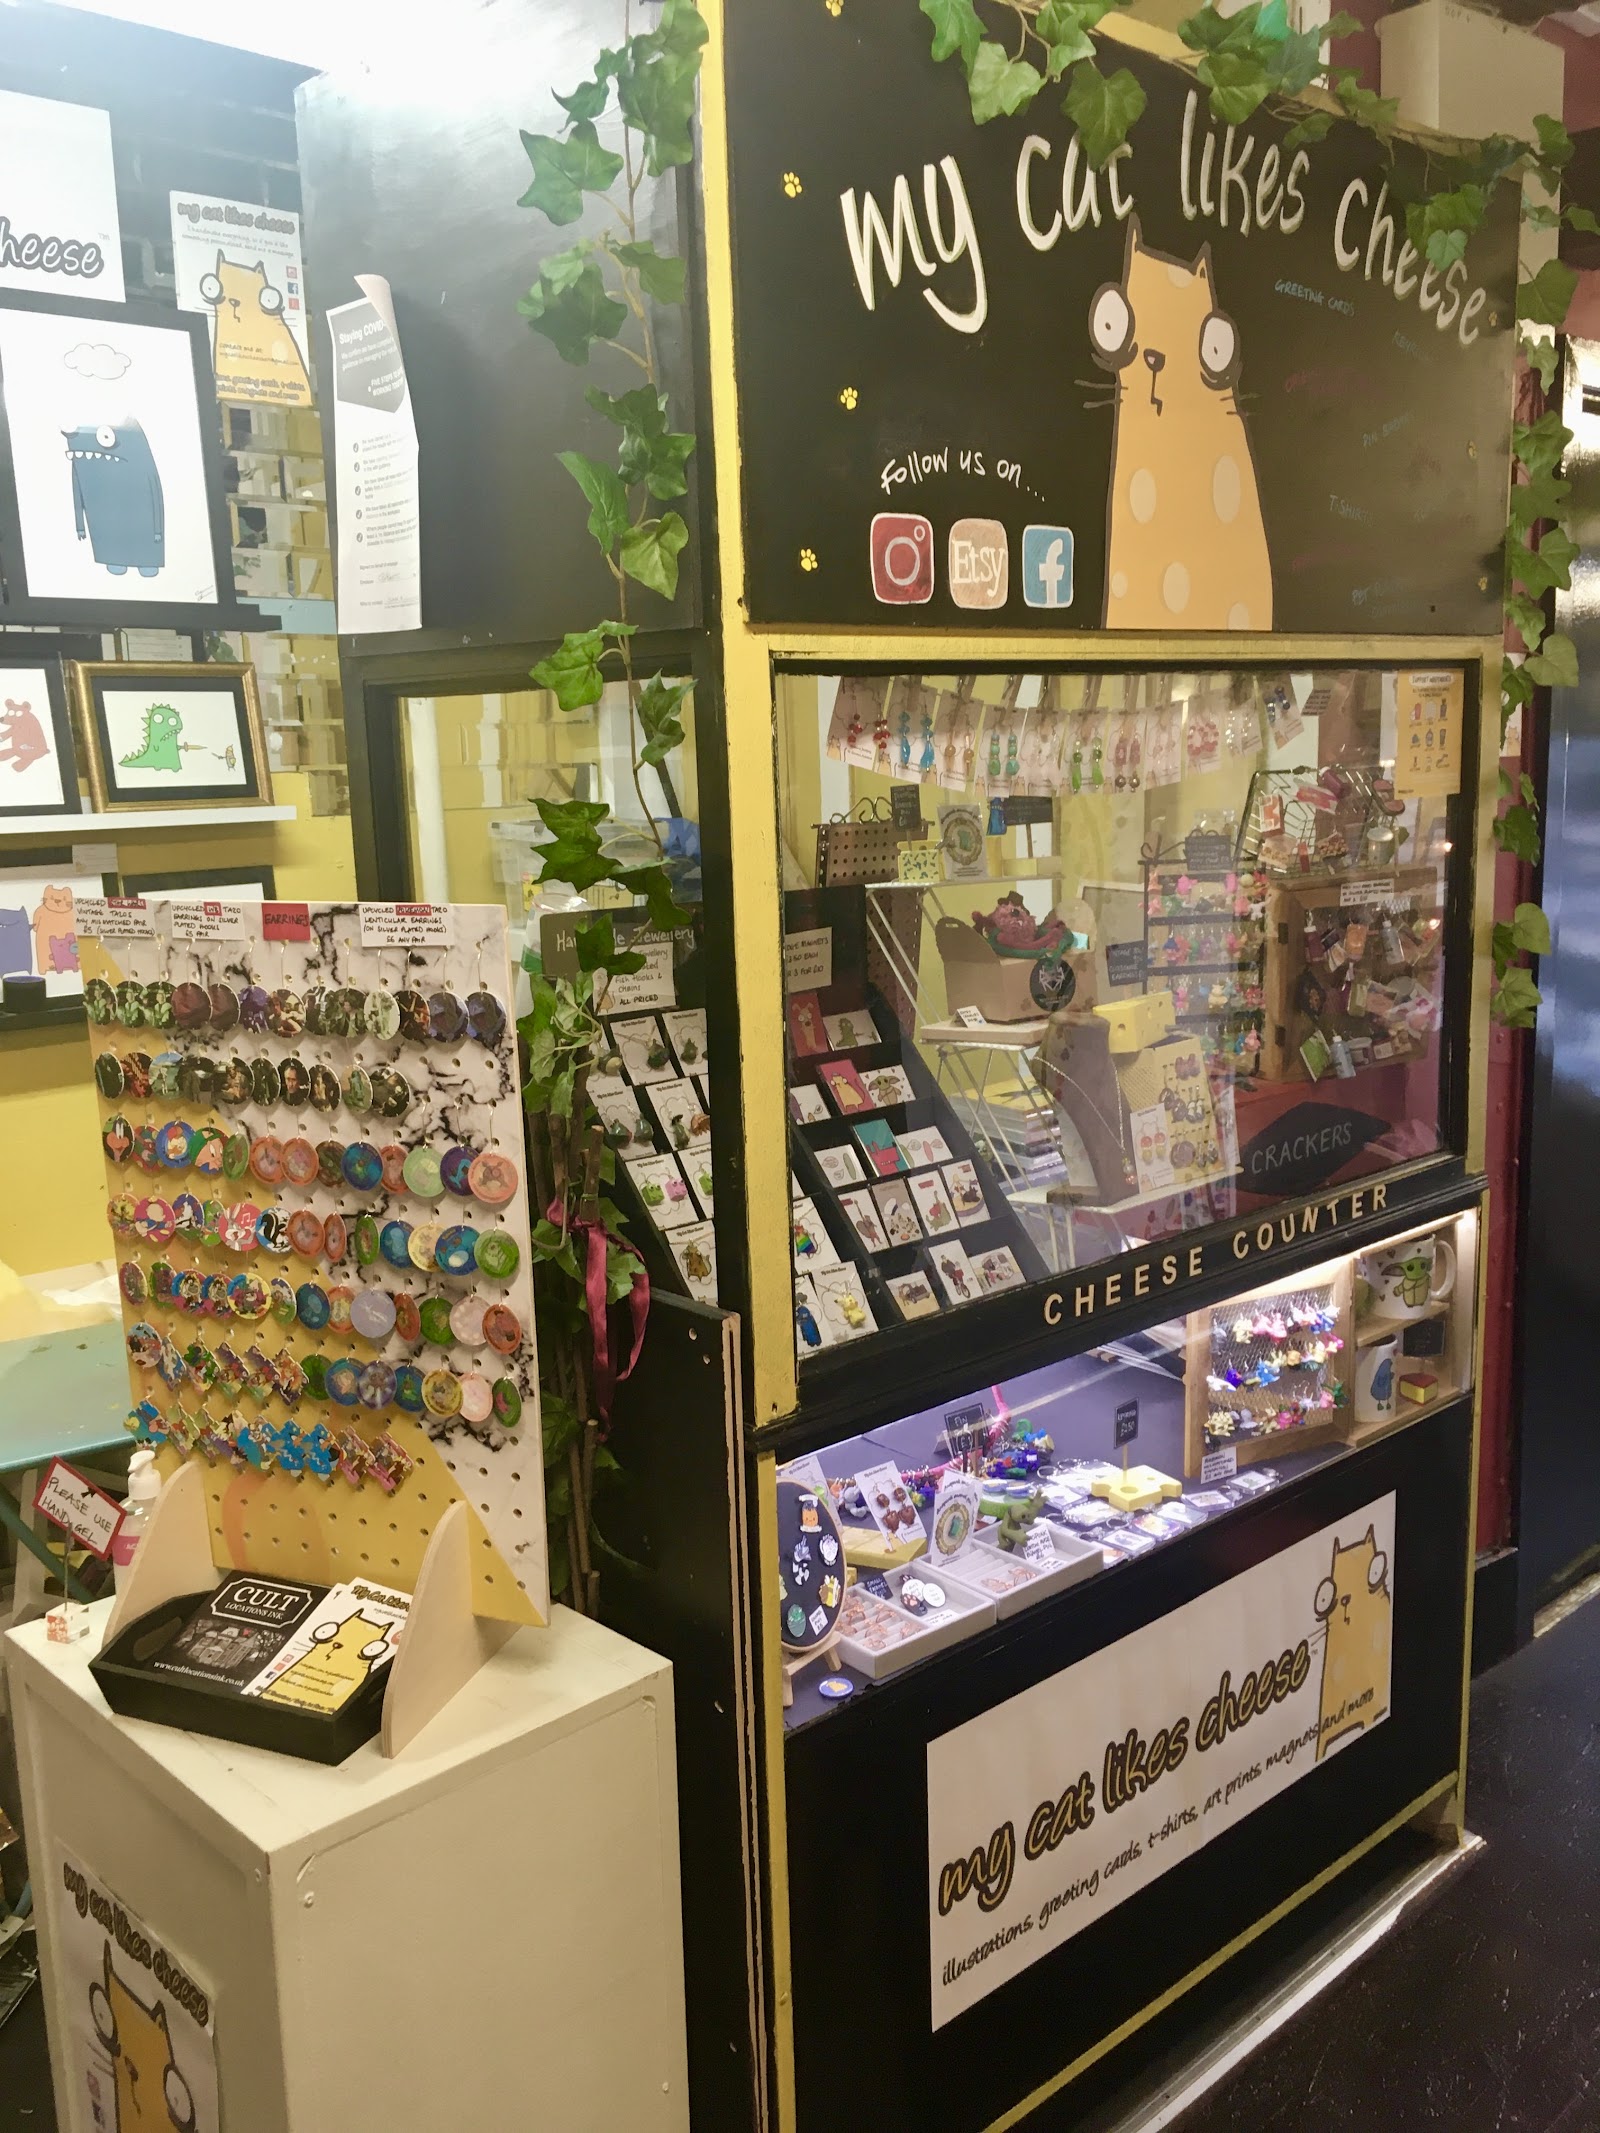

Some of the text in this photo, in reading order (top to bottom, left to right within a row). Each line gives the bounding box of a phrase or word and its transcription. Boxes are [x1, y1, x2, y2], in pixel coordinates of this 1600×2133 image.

[840, 154, 987, 333] my
[1181, 88, 1310, 238] likes
[960, 450, 985, 475] us
[952, 539, 1007, 597] Etsy
[264, 913, 310, 927] EARRINGS
[1250, 1121, 1353, 1177] CRACKERS
[1043, 1184, 1388, 1327] CHEESE COUNTER
[41, 1495, 98, 1546] HAND GEL
[48, 1476, 112, 1533] PLEASE USE
[224, 1602, 269, 1617] LOCATIONS
[233, 1586, 300, 1612] CULT
[938, 1820, 1016, 1916] my
[1024, 1771, 1095, 1861] cat
[1102, 1715, 1191, 1815] likes
[1195, 1640, 1312, 1753] cheese
[1038, 1869, 1100, 1930] greeting
[1203, 1787, 1223, 1816] art
[1266, 1722, 1319, 1771] magnets
[1320, 1699, 1345, 1734] and
[1347, 1686, 1375, 1714] more
[63, 1861, 210, 2028] my cat likes cheese
